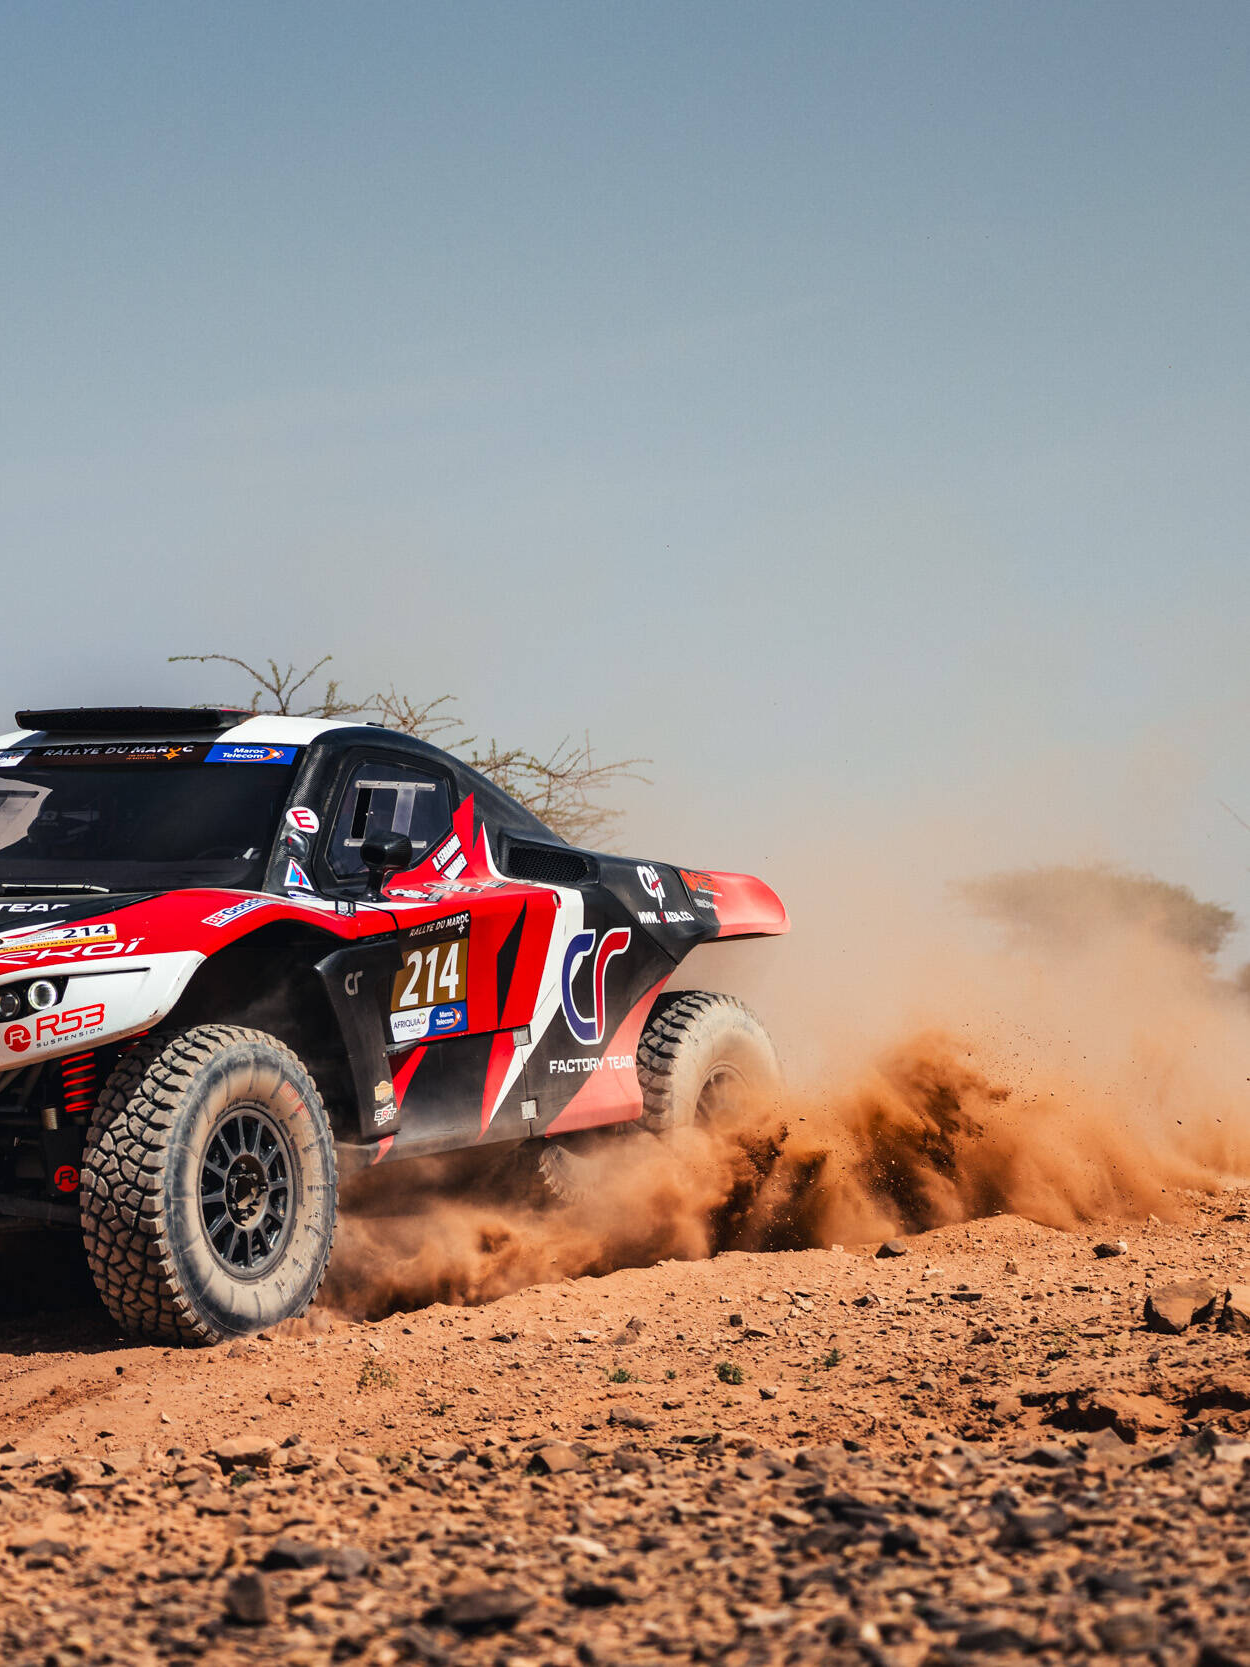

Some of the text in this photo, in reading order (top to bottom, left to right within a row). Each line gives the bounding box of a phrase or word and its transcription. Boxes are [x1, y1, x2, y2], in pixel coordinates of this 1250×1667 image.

[43, 747, 101, 757] RALLYE
[105, 746, 129, 754] DU
[291, 810, 315, 829] E
[62, 925, 111, 939] 214
[409, 913, 470, 938] RALLYE DU MAROC
[399, 942, 460, 1008] 214
[36, 1003, 105, 1041] R53
[393, 1017, 421, 1030] AFRIQUIA
[36, 1026, 104, 1049] SUSPENSION
[549, 1055, 634, 1074] FACTORY TEAM
